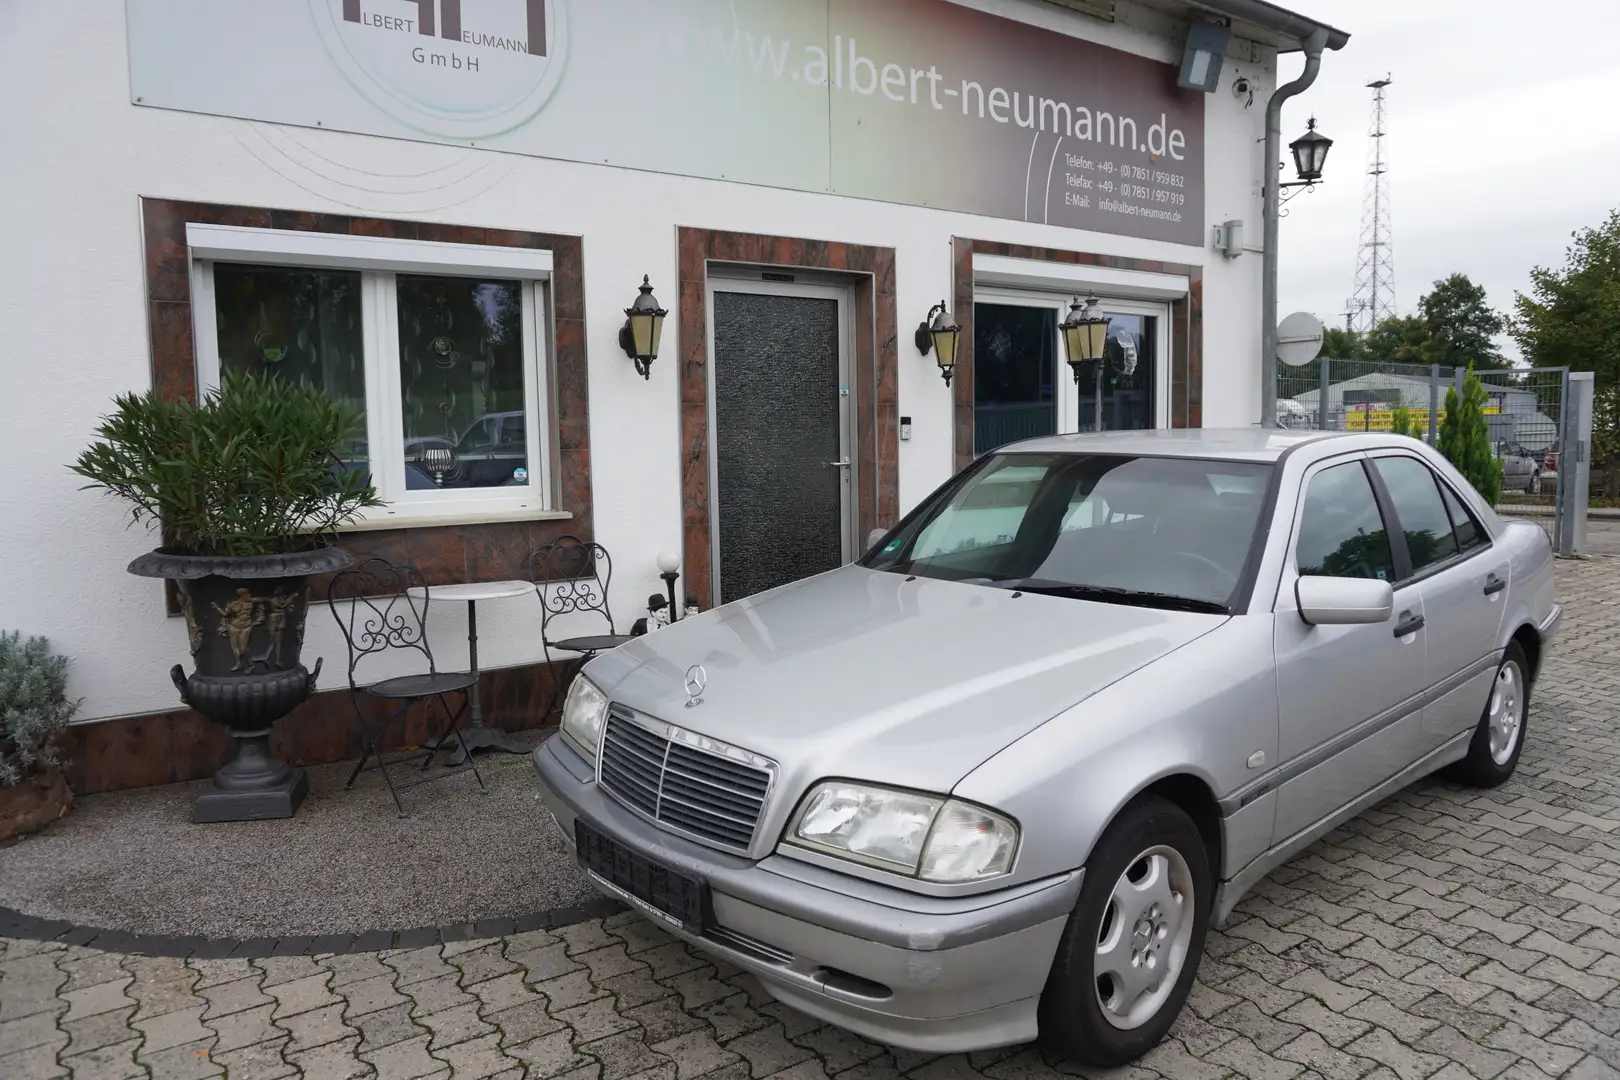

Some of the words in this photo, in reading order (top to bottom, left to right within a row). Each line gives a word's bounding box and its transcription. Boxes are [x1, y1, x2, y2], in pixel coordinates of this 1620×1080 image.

[411, 47, 480, 72] GmbH
[703, 27, 1185, 162] ww.albert-neumann.de
[1065, 153, 1094, 171] Telefon:
[1097, 161, 1113, 174] +49
[1120, 164, 1131, 178] (0)
[1132, 166, 1150, 181] 7851
[1065, 173, 1093, 189] Telefax:
[1097, 180, 1113, 193] +49
[1120, 183, 1131, 198] (0)
[1132, 185, 1150, 200] 7851
[1065, 192, 1090, 208] E-Mail:
[1098, 197, 1182, 223] info@albert-neumann.de
